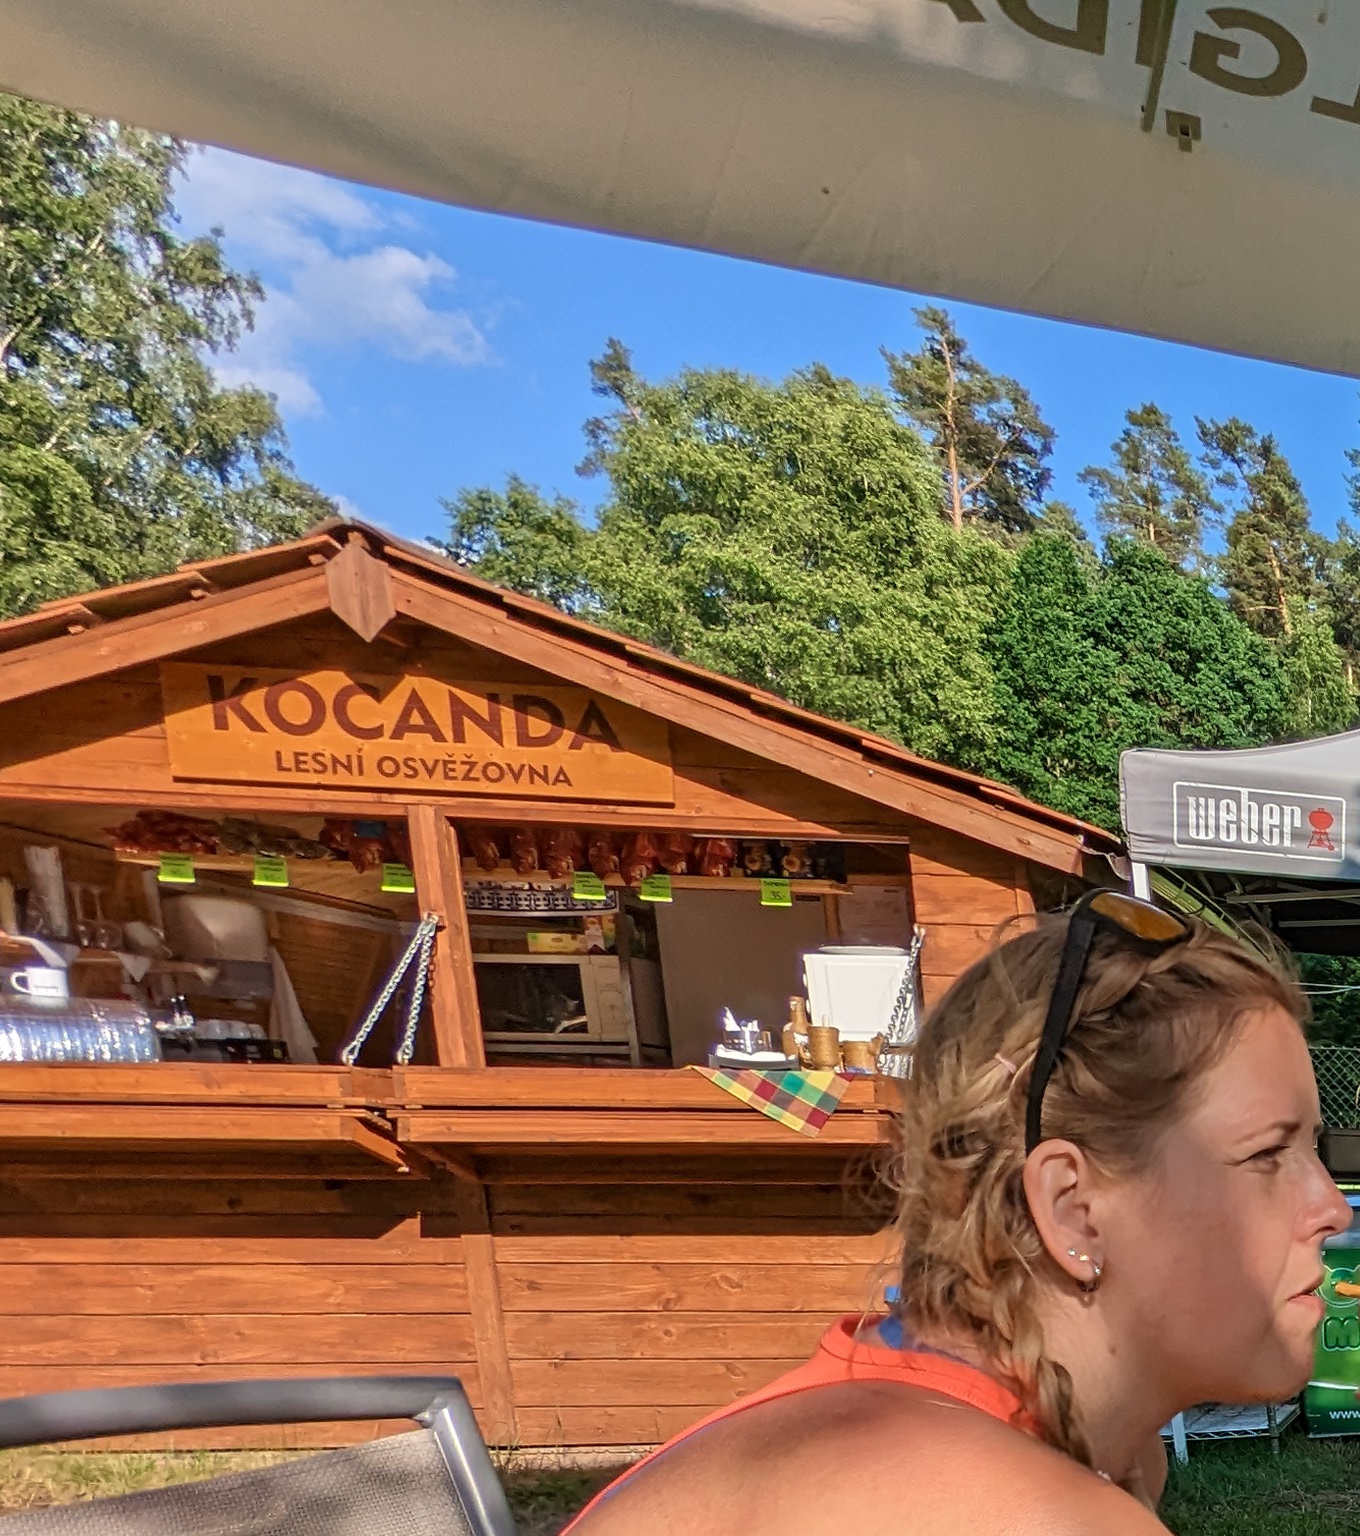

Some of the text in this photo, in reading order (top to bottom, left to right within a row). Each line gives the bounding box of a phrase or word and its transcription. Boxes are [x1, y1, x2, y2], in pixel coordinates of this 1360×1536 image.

[207, 674, 626, 753] KOCANDA
[275, 748, 574, 788] LESNÍ OSVĚŽOVNA
[1186, 788, 1302, 848] weber
